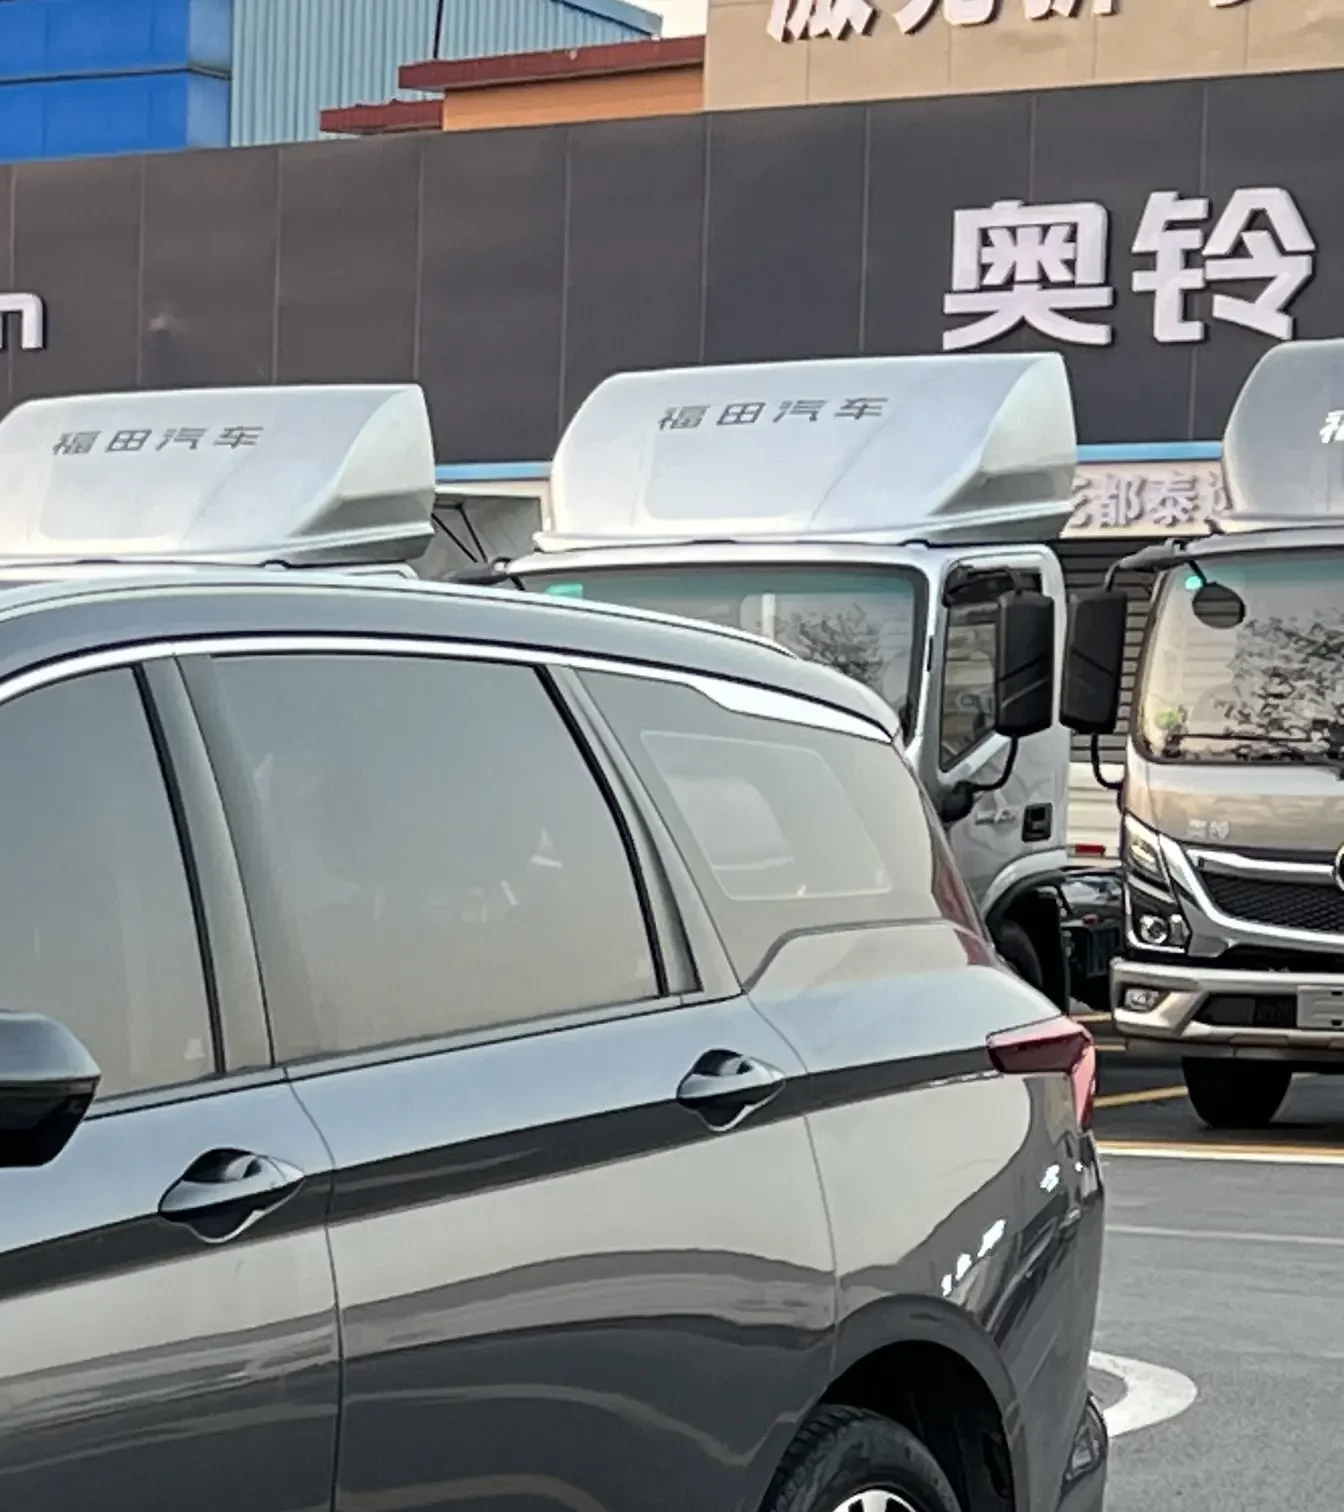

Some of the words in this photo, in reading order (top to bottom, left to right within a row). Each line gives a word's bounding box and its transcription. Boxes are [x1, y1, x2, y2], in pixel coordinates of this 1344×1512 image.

[942, 187, 1316, 351] 奥铃
[658, 396, 889, 431] 福田汽车
[52, 425, 265, 455] 福田汽车
